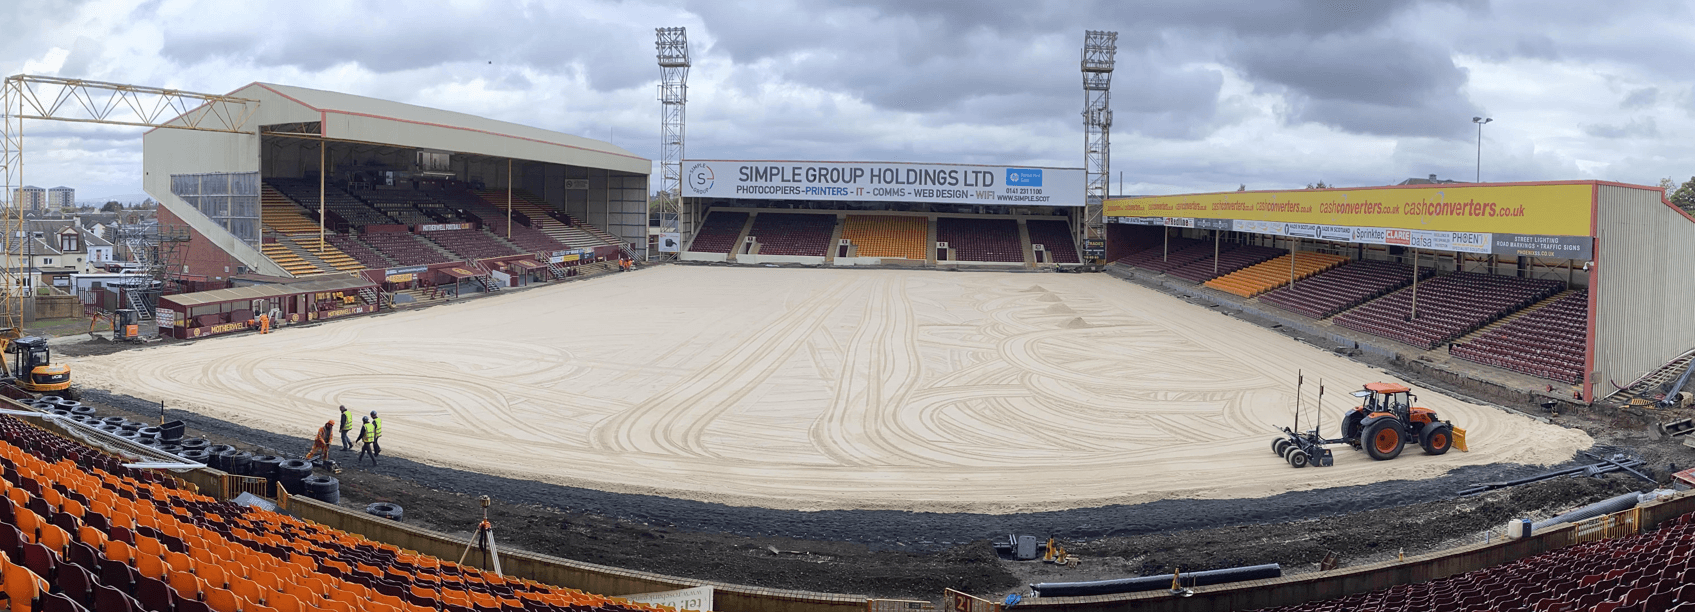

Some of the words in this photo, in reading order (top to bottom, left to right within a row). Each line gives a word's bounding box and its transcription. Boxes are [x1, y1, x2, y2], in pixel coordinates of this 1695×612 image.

[689, 163, 706, 174] SIMPLE
[697, 173, 706, 185] S
[739, 166, 802, 183] SIMPLE
[805, 166, 864, 184] GROUP
[870, 168, 959, 186] HOLDINGS
[964, 170, 994, 187] LTD
[872, 188, 906, 197] COMMS
[914, 189, 935, 198] WEB
[936, 190, 968, 199] DESIGN
[975, 190, 995, 200] WIFI
[1319, 200, 1400, 214] cashconverters.co.uk
[1404, 198, 1525, 217] cashconverters.co.uk
[1356, 228, 1385, 241] Sprinktec
[1411, 234, 1432, 247] bafsa
[1497, 240, 1509, 248] ROAD
[680, 598, 702, 610] tel:
[957, 596, 970, 612] 21
